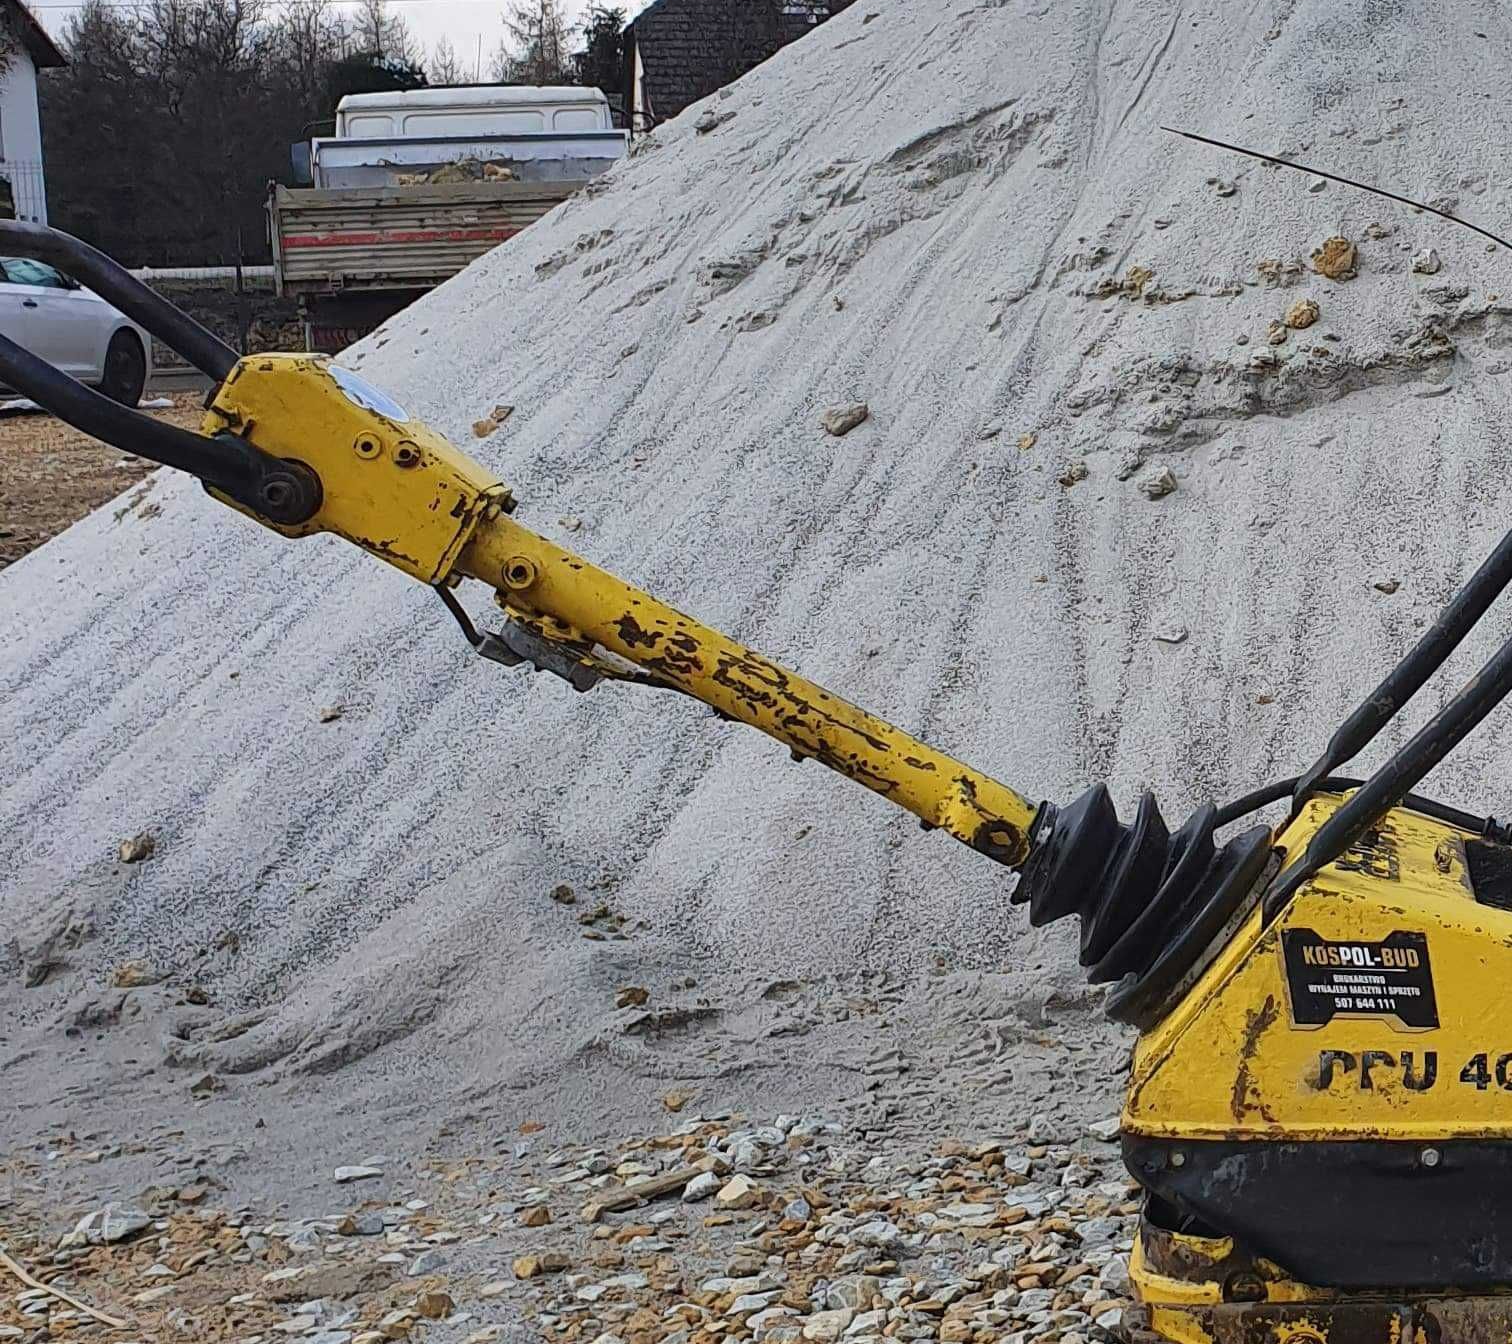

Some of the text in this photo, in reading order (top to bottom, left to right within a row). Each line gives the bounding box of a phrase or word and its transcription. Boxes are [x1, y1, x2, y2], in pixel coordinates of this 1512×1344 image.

[1334, 997, 1396, 1010] 507 644 111
